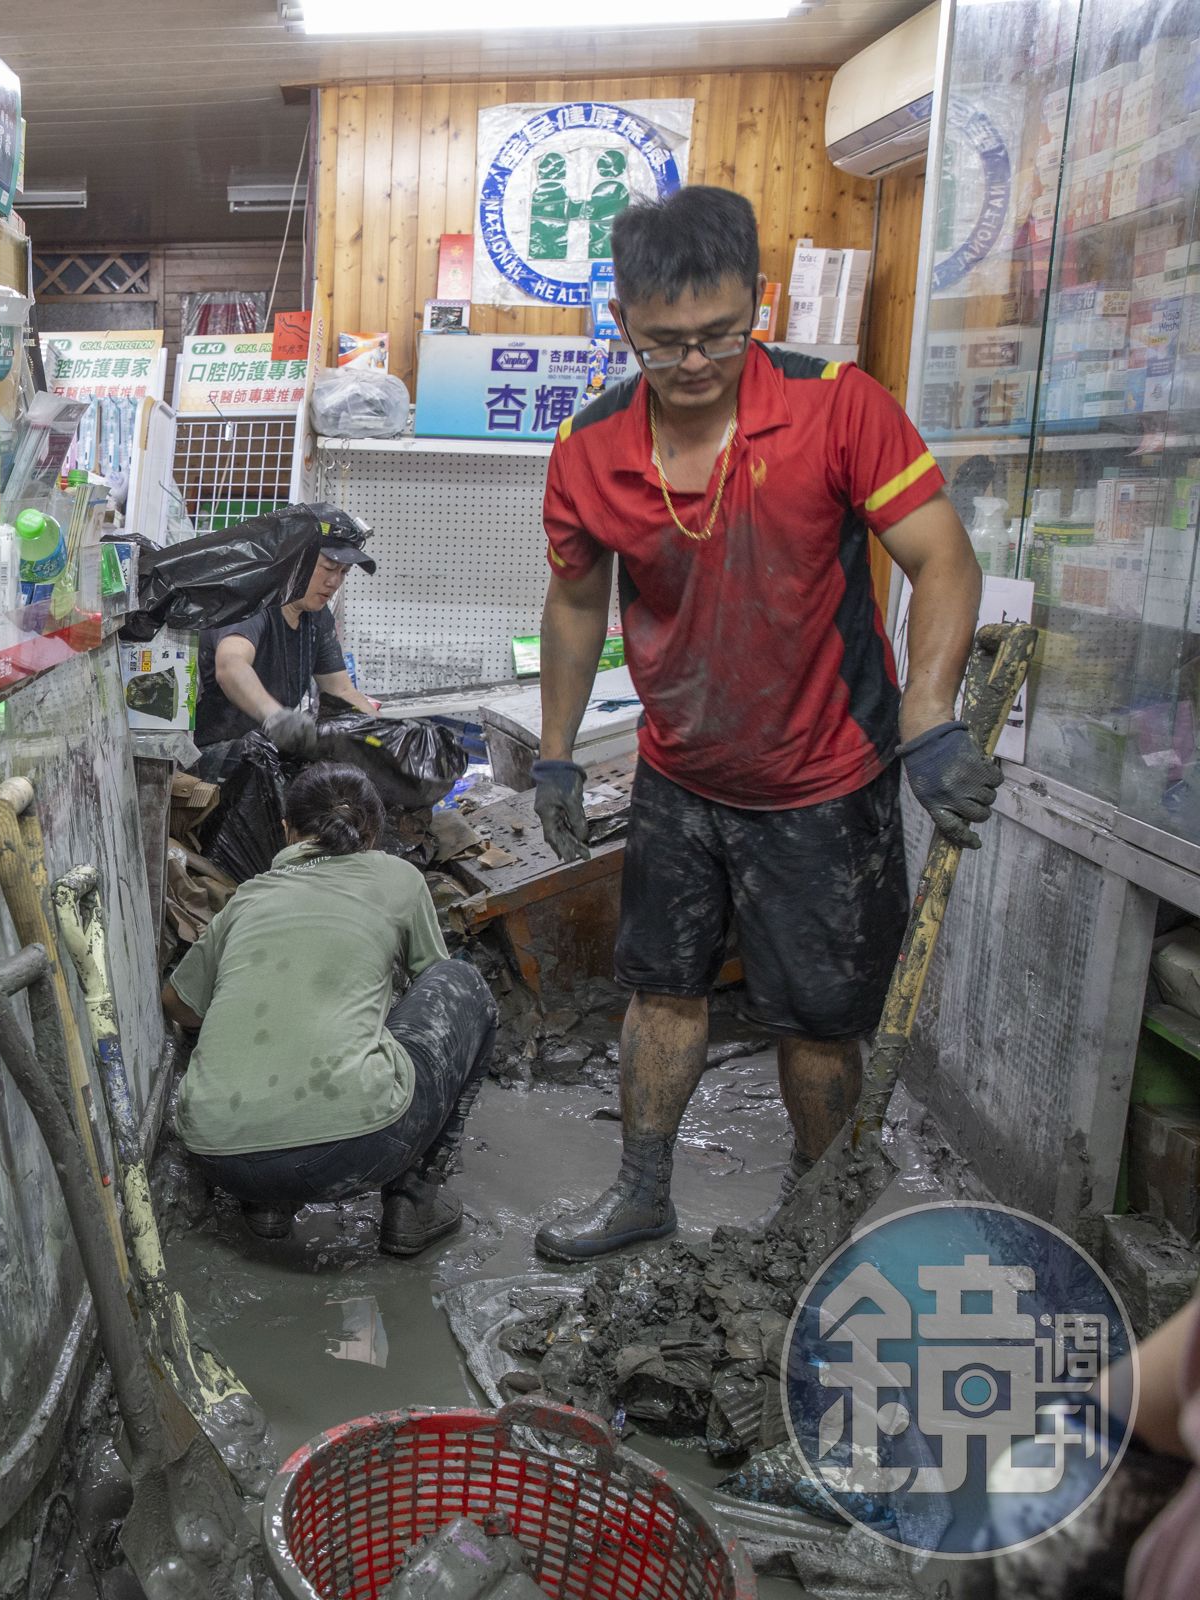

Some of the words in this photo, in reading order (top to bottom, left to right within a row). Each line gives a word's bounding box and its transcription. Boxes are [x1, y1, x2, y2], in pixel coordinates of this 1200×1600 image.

[490, 104, 672, 174] 全民健康保險
[484, 203, 522, 281] NATIONAL
[534, 281, 590, 302] HEALT
[80, 341, 102, 350] ORAL
[105, 340, 155, 349] PROTECTION
[194, 344, 222, 353] T.KI
[235, 345, 256, 354] ORAL
[502, 355, 530, 369] Sinphar
[551, 350, 628, 365] 杏輝醫集團
[56, 359, 151, 379] 腔防護專家
[188, 360, 307, 382] 口腔防護專家
[548, 365, 588, 374] SINPHAR
[485, 384, 578, 433] 杏輝
